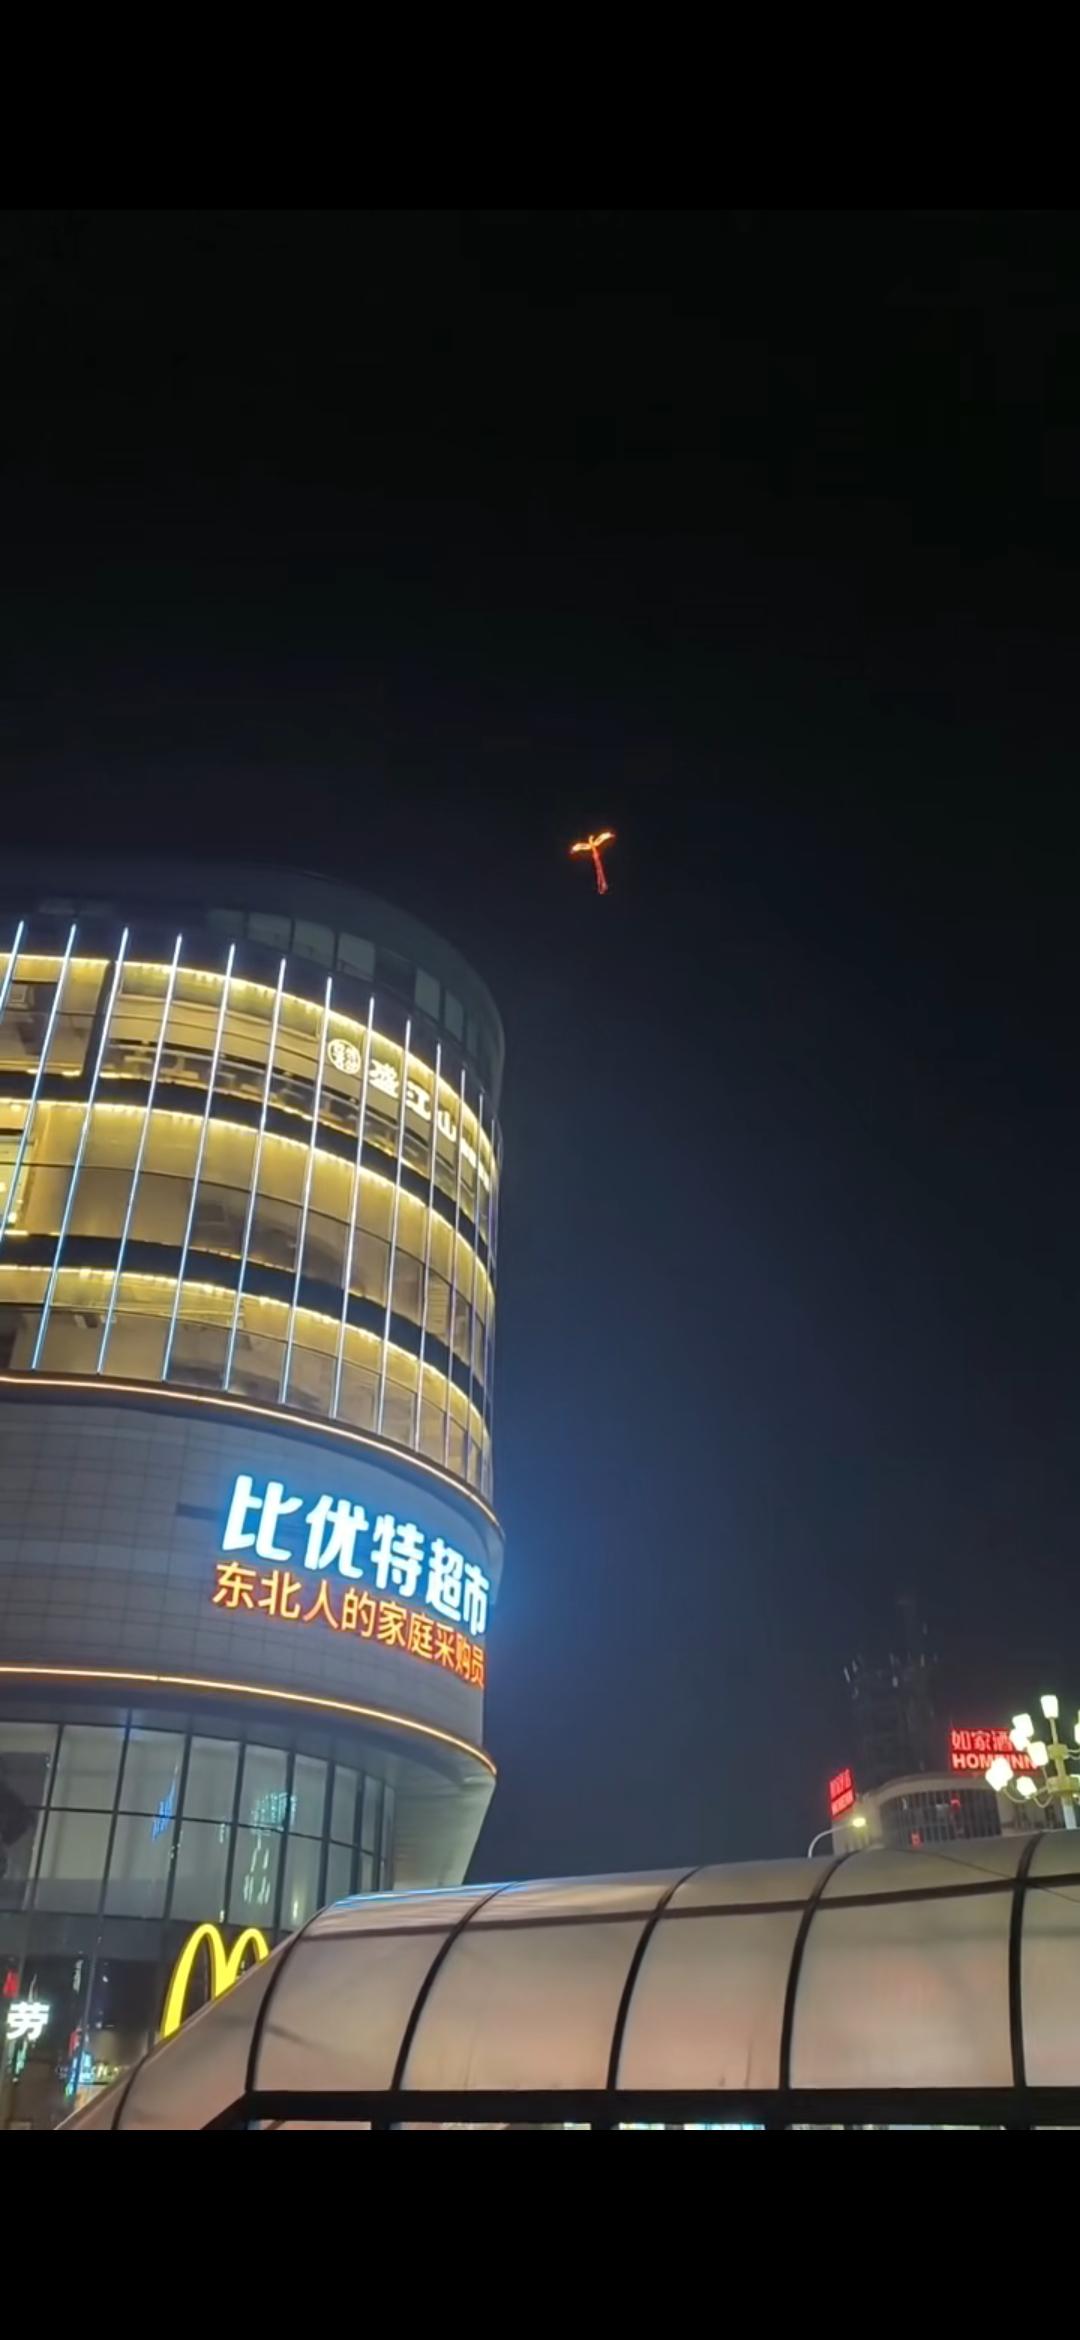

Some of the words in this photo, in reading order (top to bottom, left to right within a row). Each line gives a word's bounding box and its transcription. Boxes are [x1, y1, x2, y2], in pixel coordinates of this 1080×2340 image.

[222, 1474, 490, 1636] 比优特超市
[212, 1561, 485, 1689] 东北人的家庭采购员
[952, 1730, 1015, 1751] 如家酒
[6, 2001, 50, 2041] 劳
